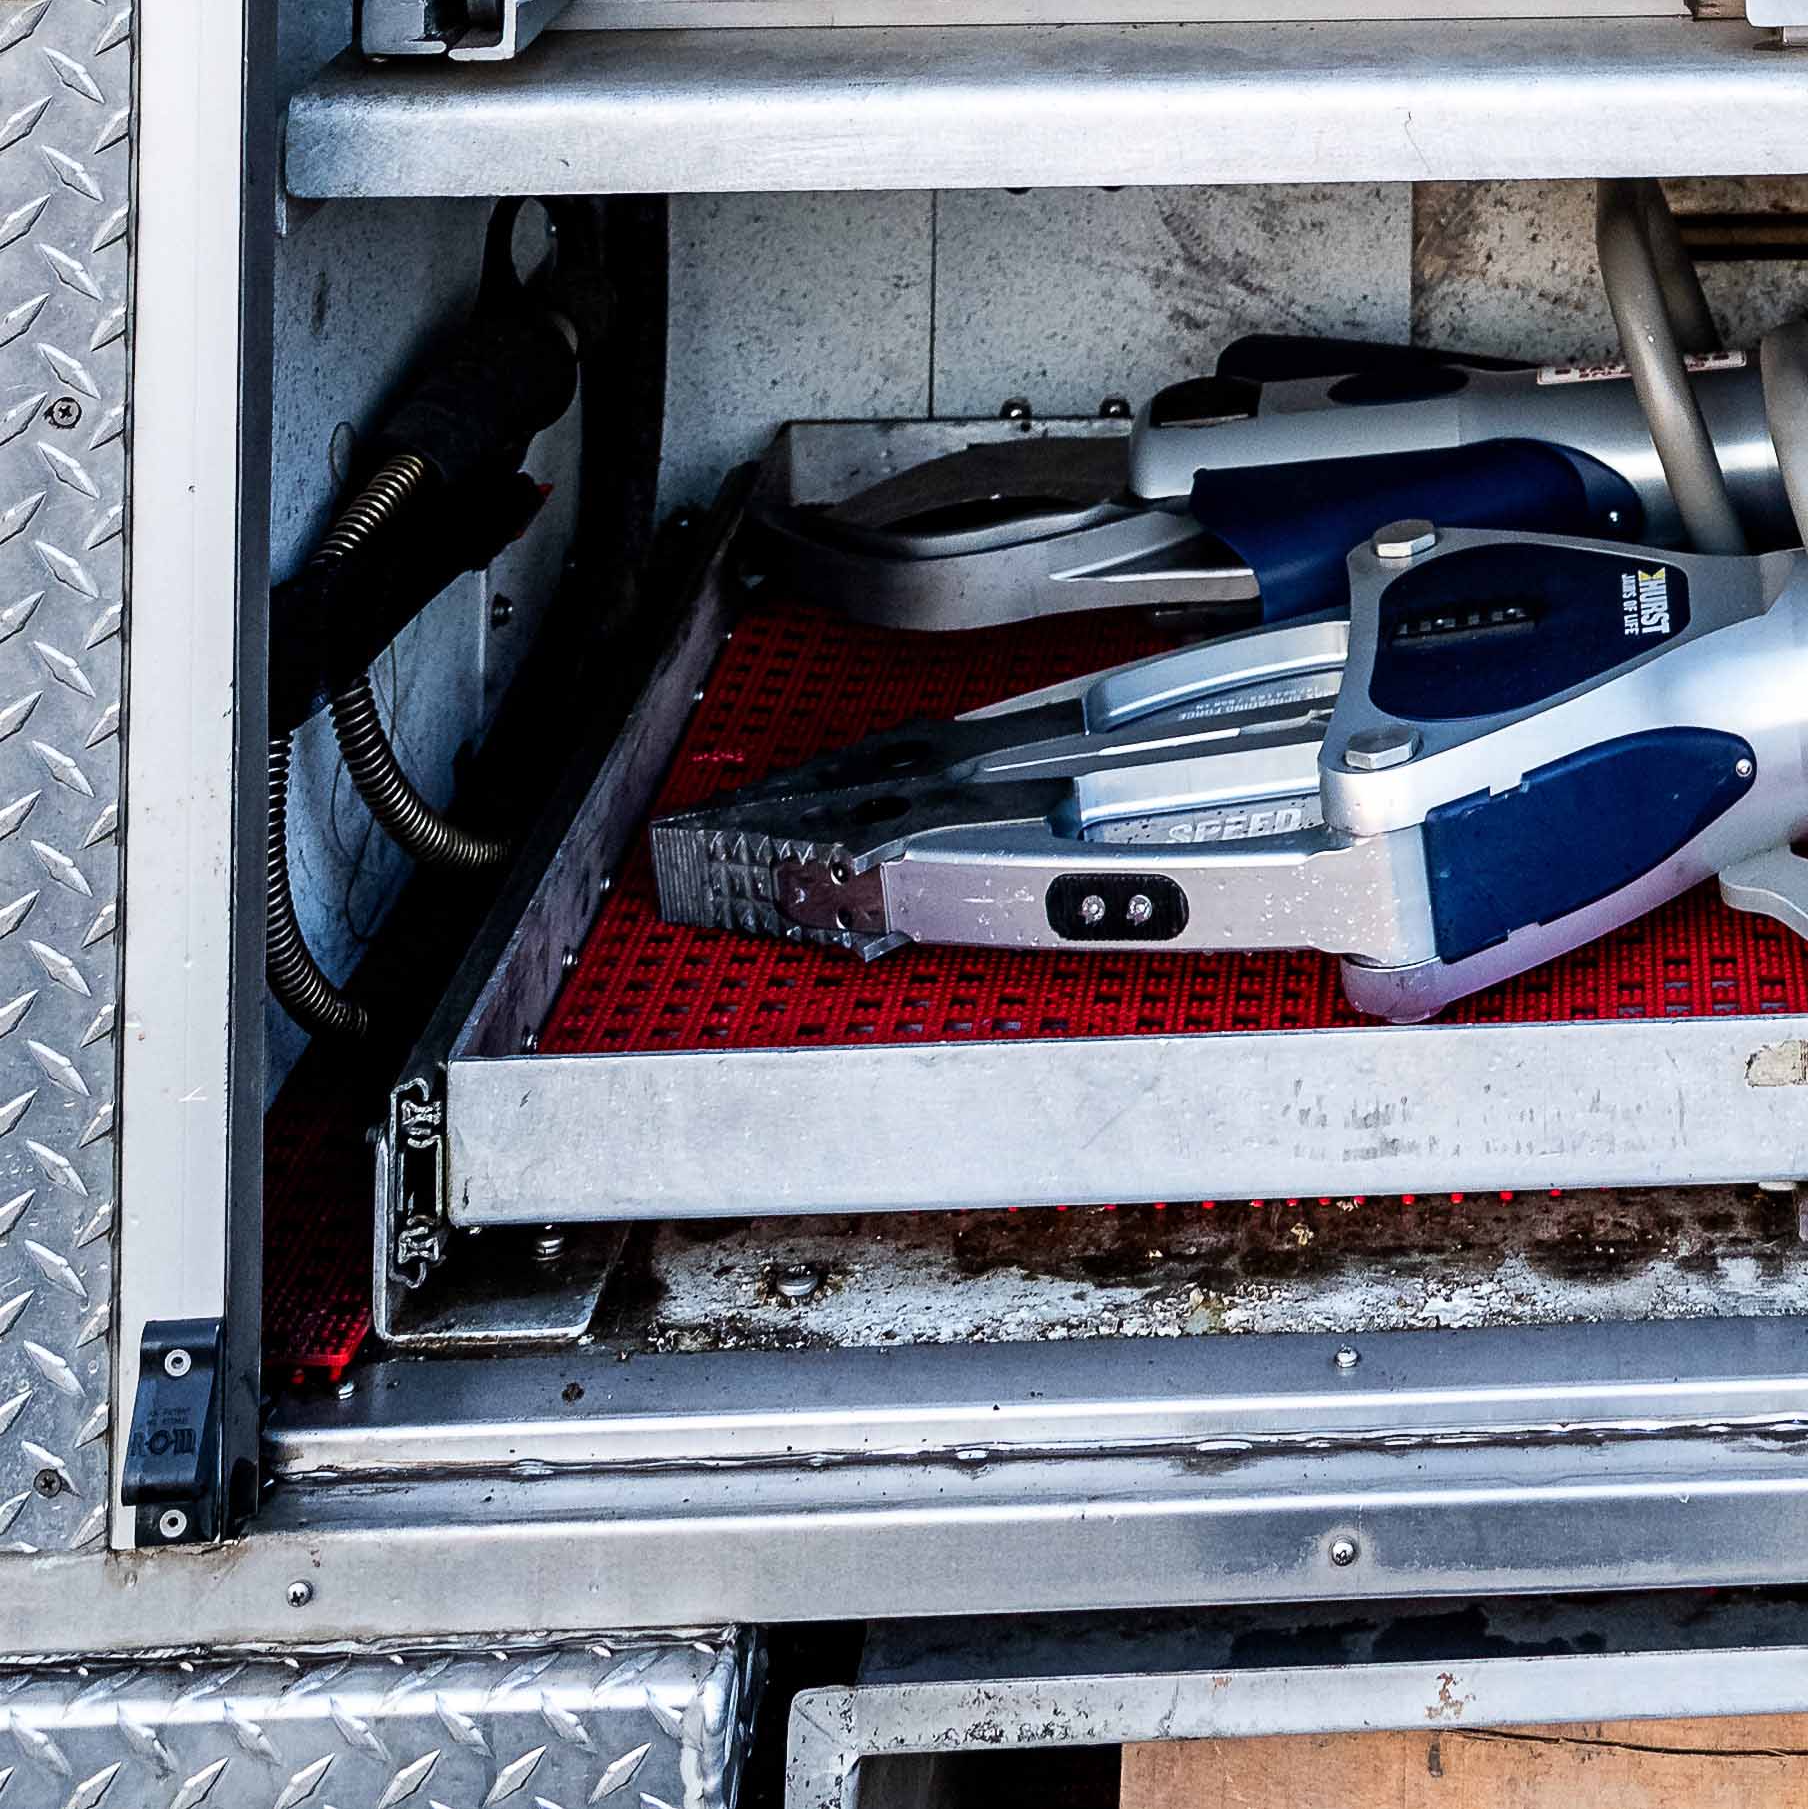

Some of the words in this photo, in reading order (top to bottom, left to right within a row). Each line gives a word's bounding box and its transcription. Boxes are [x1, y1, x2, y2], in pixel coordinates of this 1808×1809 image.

[1621, 574, 1637, 598] JAWS
[1623, 600, 1638, 612] OF
[1639, 580, 1670, 634] HURST
[1624, 613, 1639, 636] LIFE
[1166, 808, 1302, 844] SPEED
